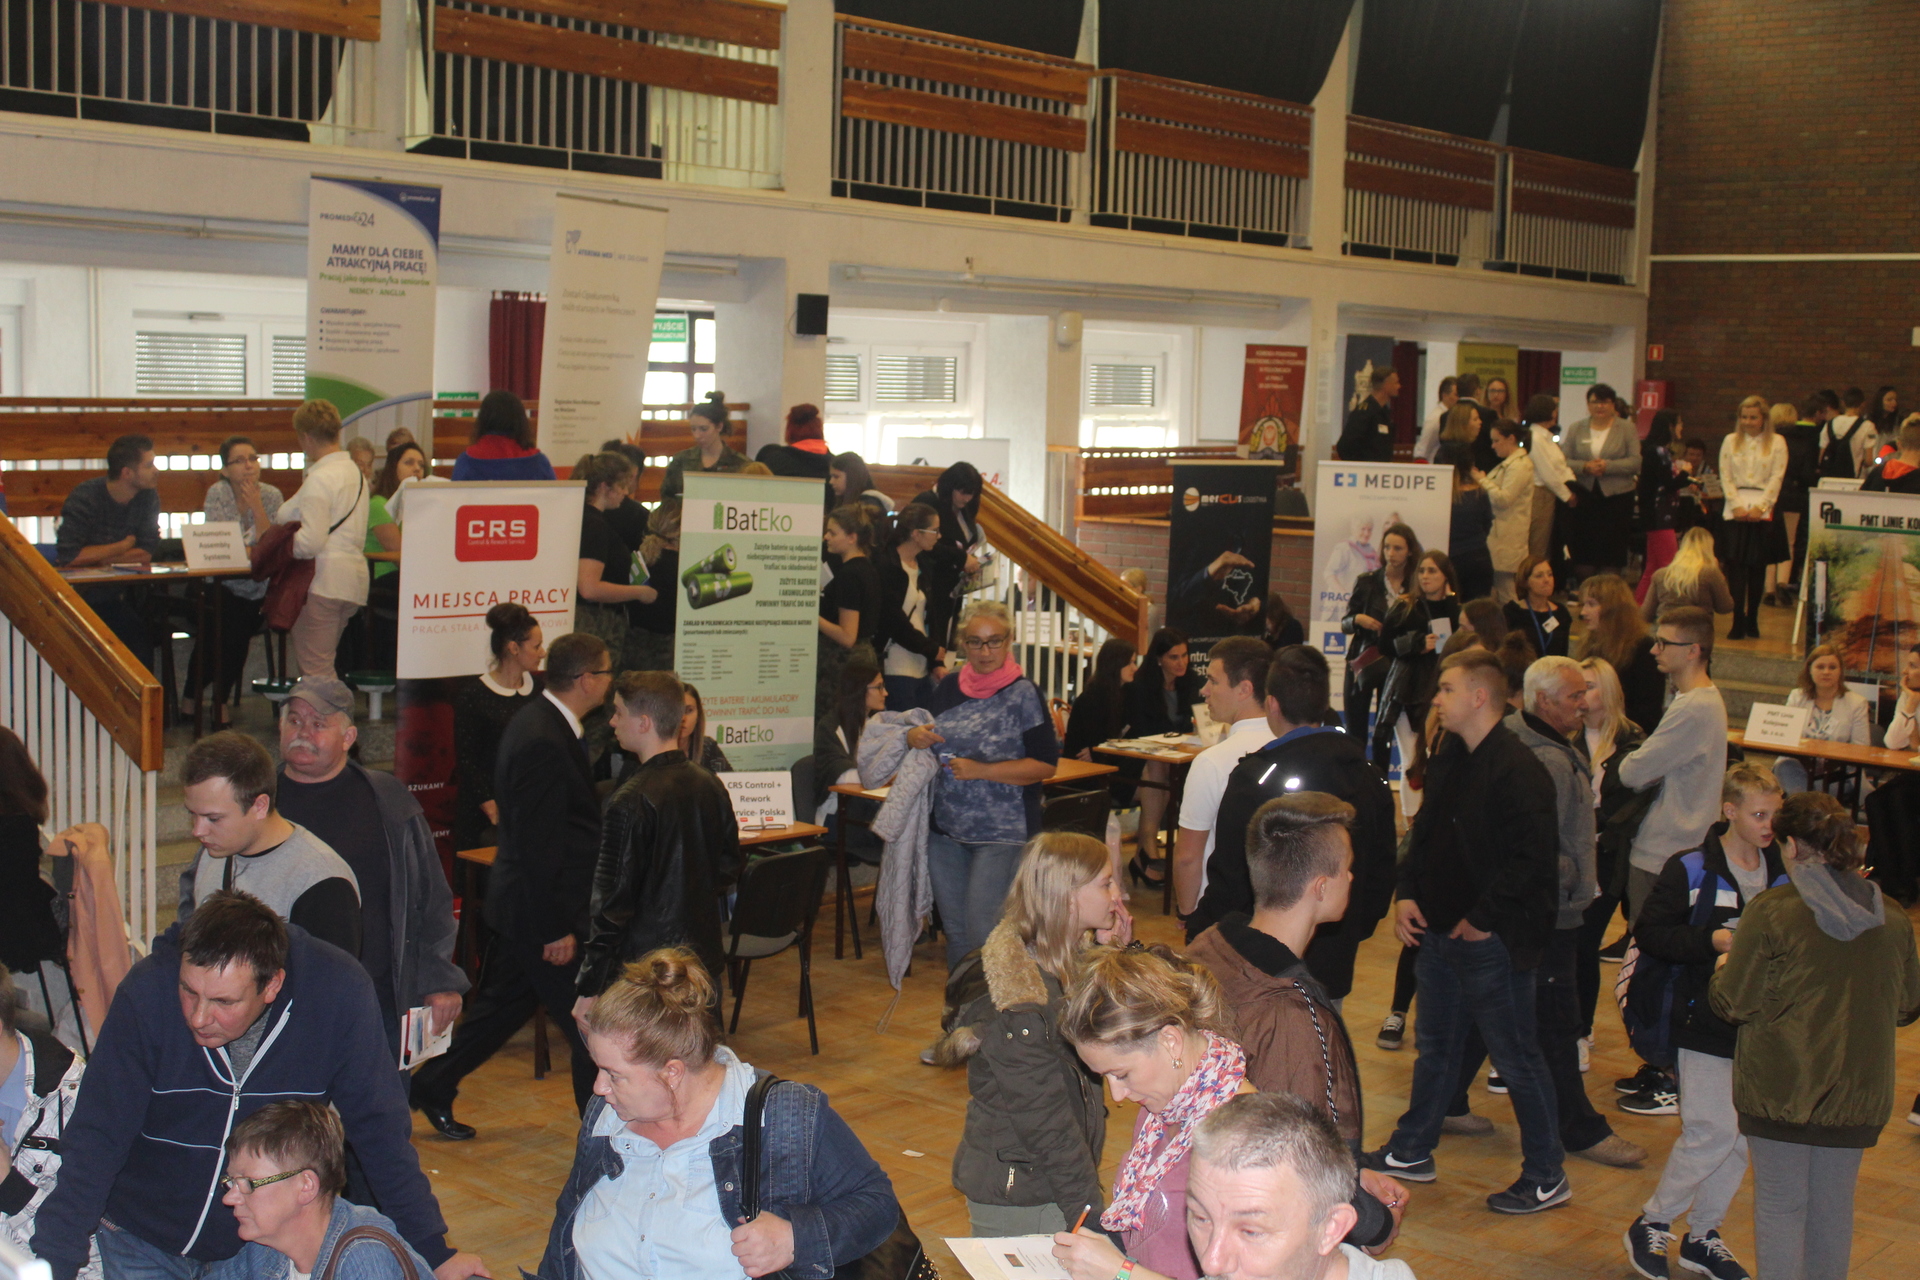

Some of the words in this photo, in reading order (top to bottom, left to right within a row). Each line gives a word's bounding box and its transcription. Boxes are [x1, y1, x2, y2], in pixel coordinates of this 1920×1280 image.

[332, 244, 366, 256] MAMY
[368, 246, 389, 258] DLA
[392, 247, 423, 259] CIEBIE
[326, 256, 391, 273] ATRAKCYJNĄ
[393, 260, 427, 275] PRACĘ!
[349, 287, 374, 295] NIEMCY
[379, 288, 406, 297] ANGLIA
[1364, 474, 1436, 490] MEDIPE
[726, 507, 793, 532] BatEko
[1861, 514, 1879, 526] PMT
[1882, 516, 1904, 528] LINIE
[468, 520, 526, 538] CRS
[199, 542, 230, 550] Assembly
[413, 591, 499, 609] MIEJSCA
[508, 588, 569, 605] PRACY
[1320, 592, 1350, 601] PRAC
[412, 624, 447, 634] PRACA
[450, 622, 480, 633] STAŁA
[719, 696, 745, 705] BATERIE
[750, 694, 800, 704] AKUMULATORY
[738, 705, 761, 715] TRAFIĆ
[762, 706, 774, 714] DO
[775, 705, 789, 714] NAS
[725, 725, 774, 744] BatEko
[408, 782, 444, 792] SZUKAMY
[728, 781, 743, 789] CRS
[745, 781, 775, 789] Control
